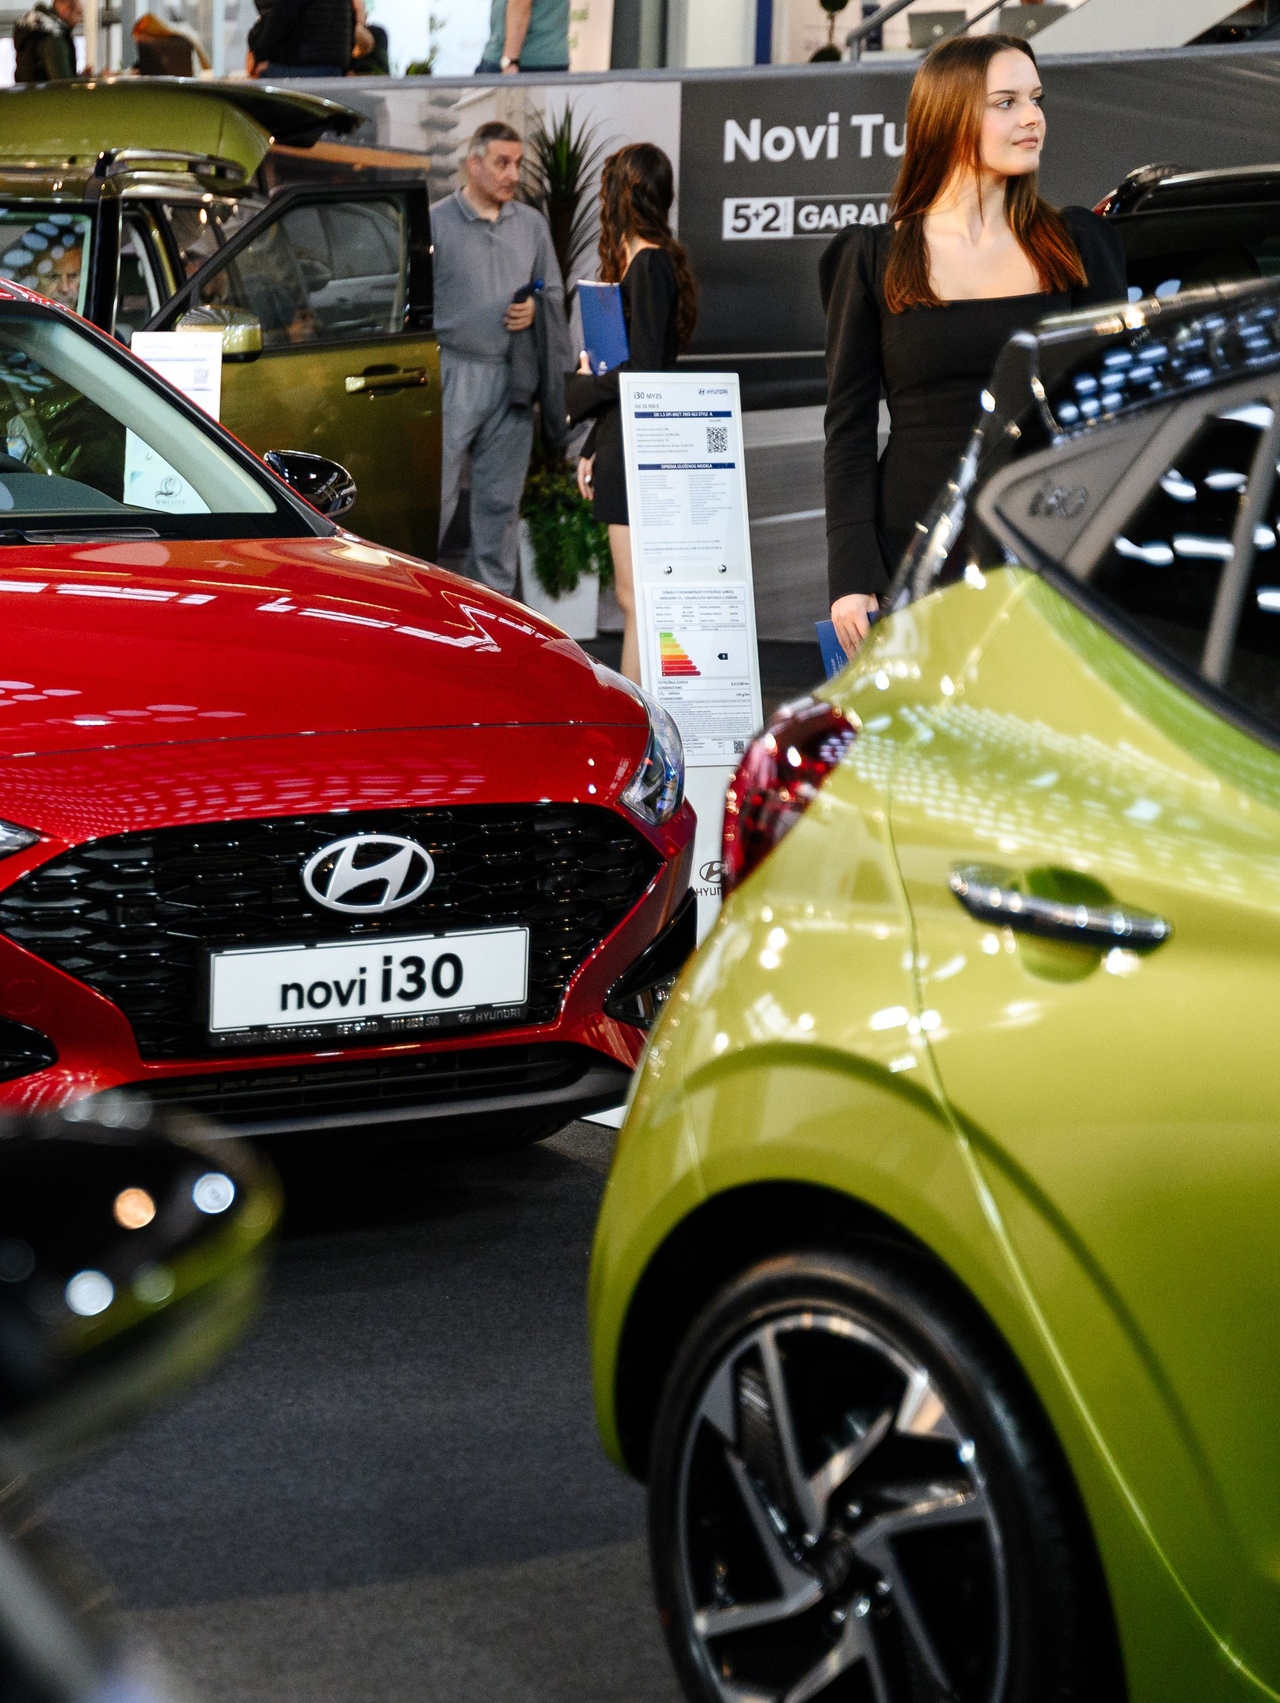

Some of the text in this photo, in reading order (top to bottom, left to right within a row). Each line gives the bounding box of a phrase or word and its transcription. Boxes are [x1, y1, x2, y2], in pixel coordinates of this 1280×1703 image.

[723, 111, 840, 163] Novi
[633, 391, 645, 400] i30
[280, 952, 464, 1011] novi i30
[475, 1008, 520, 1021] HYUNDAI
